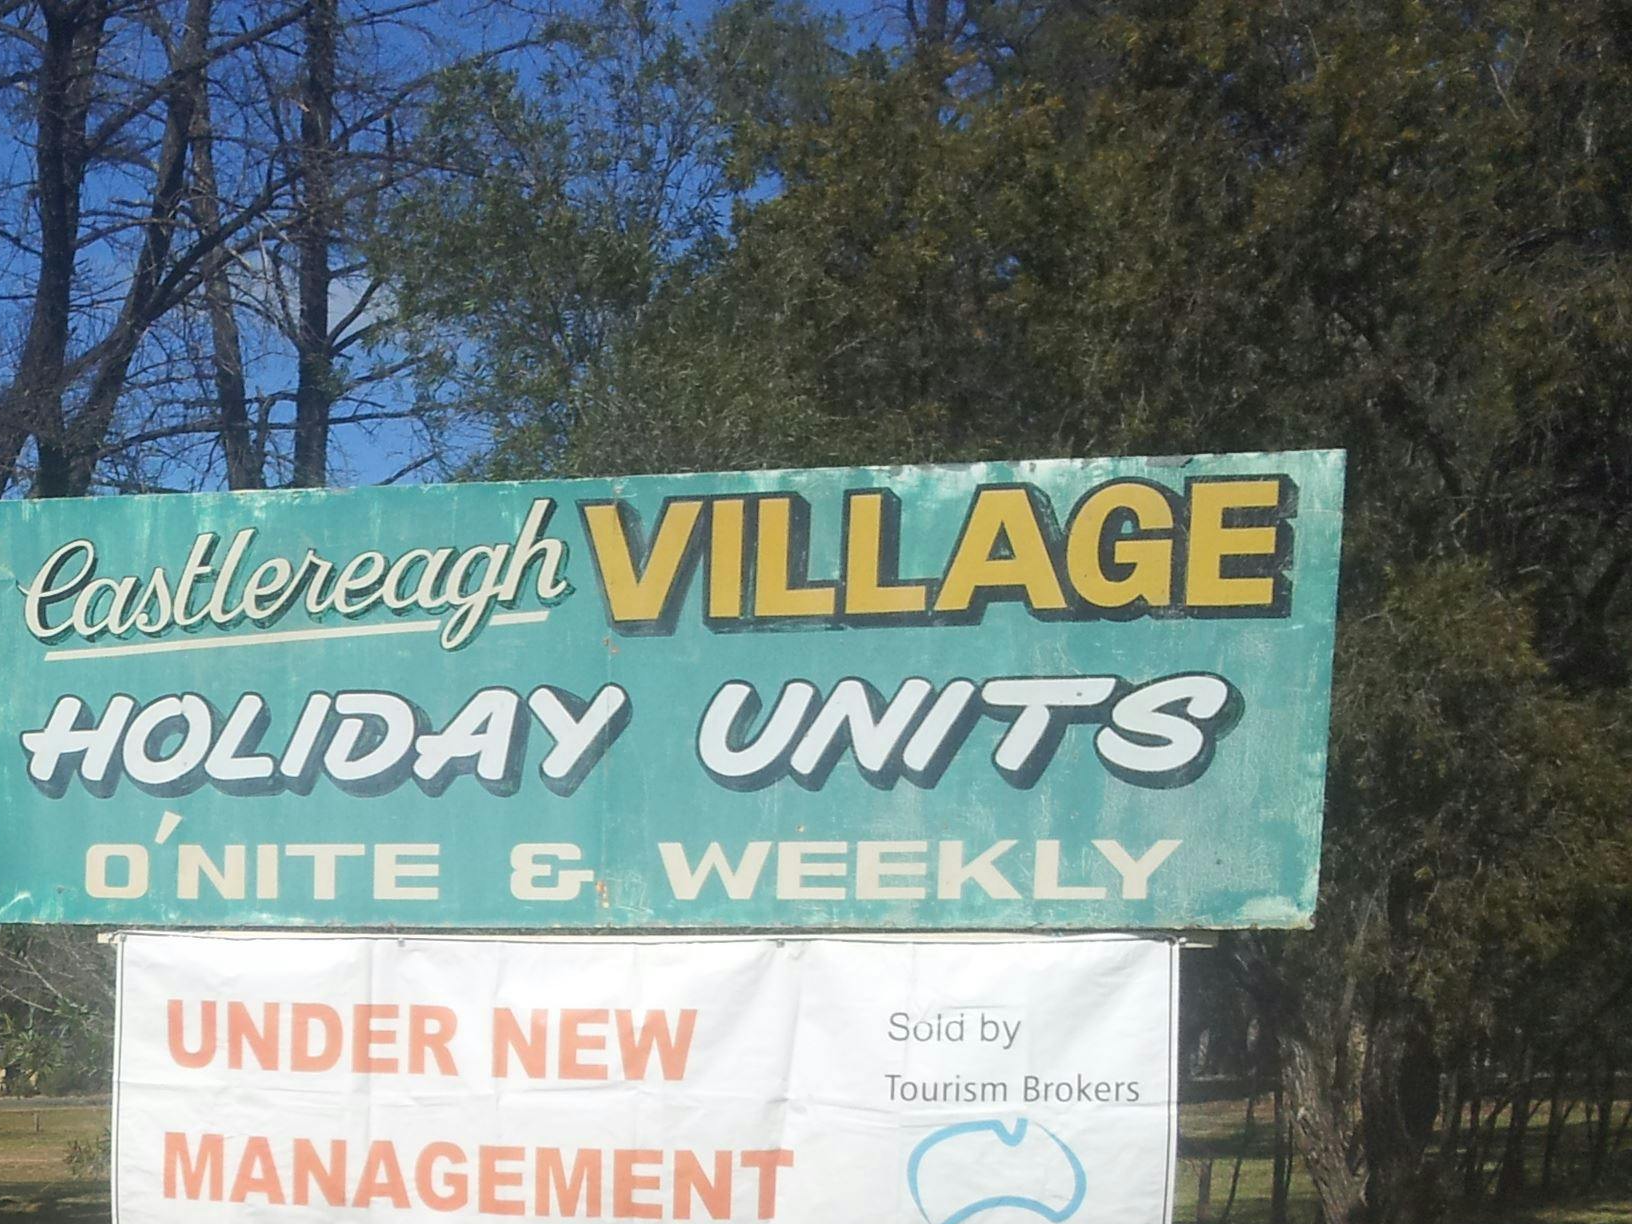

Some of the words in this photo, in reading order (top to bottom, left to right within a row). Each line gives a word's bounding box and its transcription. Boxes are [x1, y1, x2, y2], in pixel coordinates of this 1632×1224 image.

[18, 498, 571, 651] Castlereagh
[581, 477, 1288, 628] VILLAGE
[22, 684, 628, 792] HOLIDAY
[697, 674, 1236, 784] UNITS
[85, 811, 440, 900] O'NITE
[509, 842, 595, 901] &
[659, 839, 1183, 900] WEEKLY
[166, 999, 458, 1076] UNDER
[492, 1007, 698, 1081] NEW
[888, 1012, 965, 1042] Sold
[980, 1012, 1021, 1049] by
[885, 1074, 1008, 1102] Tourism
[1023, 1073, 1140, 1102] Brokers
[161, 1132, 795, 1221] MANAGEMENT
